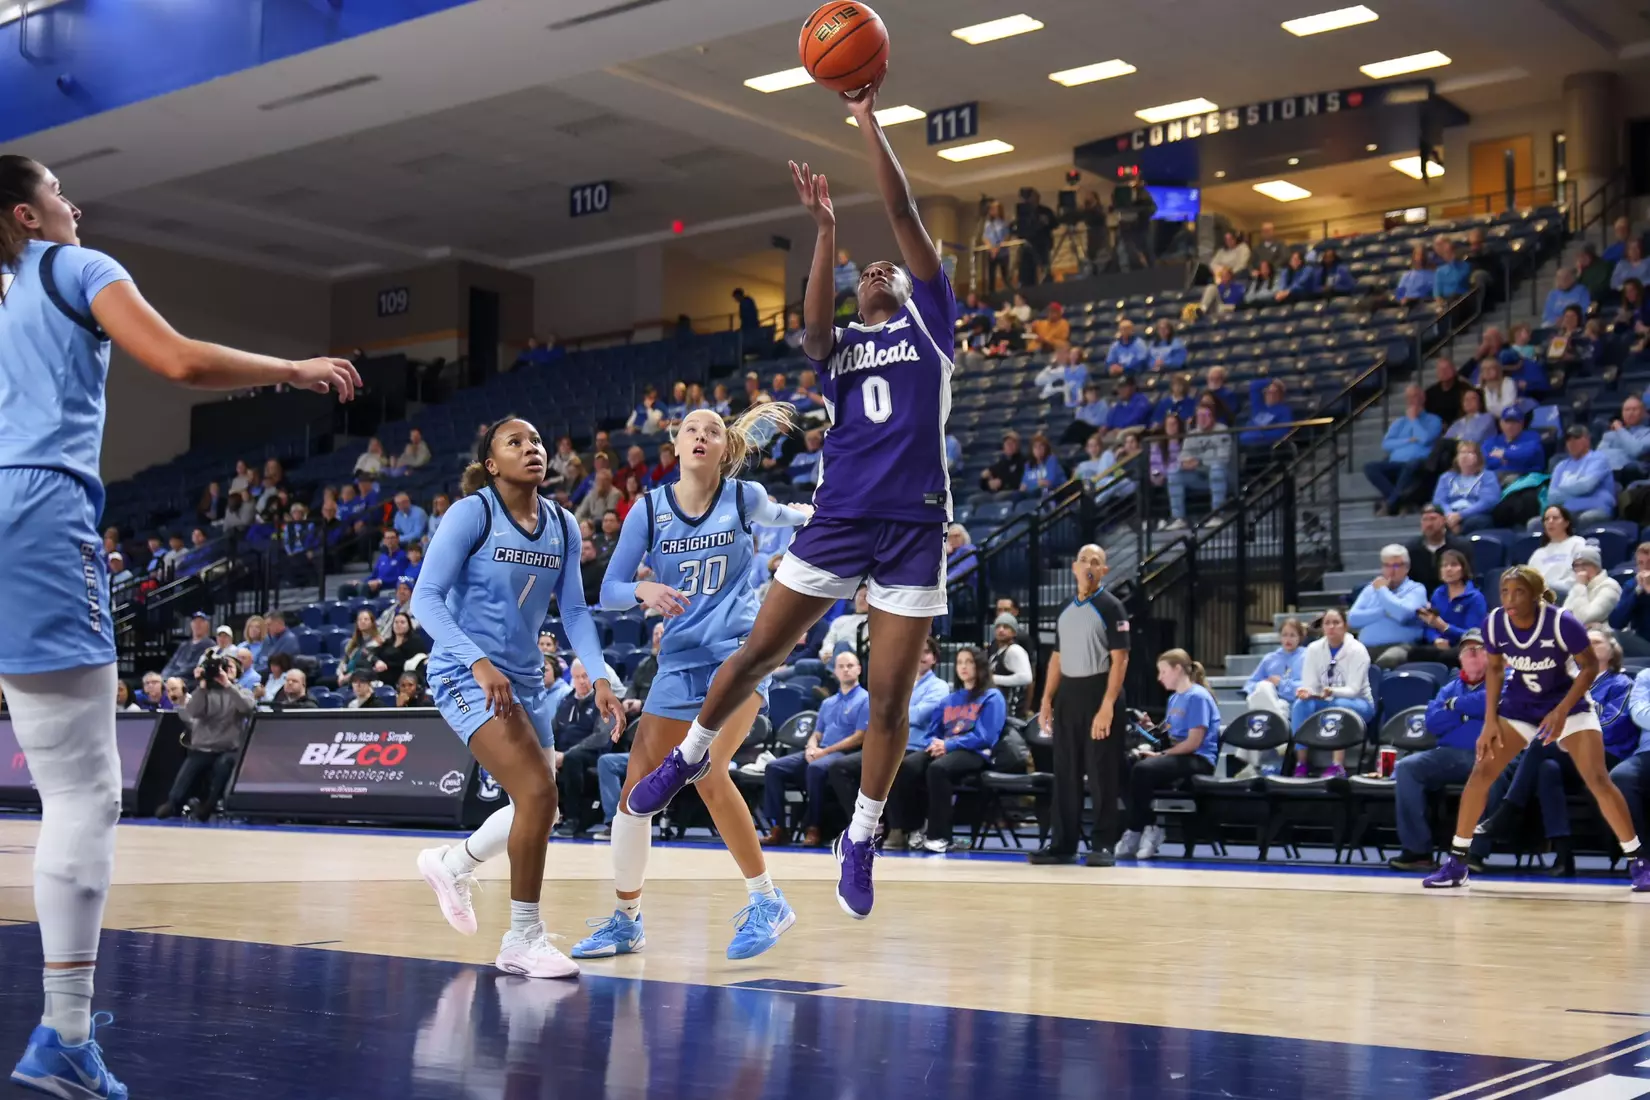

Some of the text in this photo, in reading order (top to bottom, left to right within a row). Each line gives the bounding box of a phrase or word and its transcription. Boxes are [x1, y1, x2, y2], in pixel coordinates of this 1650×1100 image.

[932, 106, 971, 140] 111
[1131, 92, 1341, 150] CONCESSIONS
[573, 184, 607, 214] 110
[380, 290, 407, 314] 109
[828, 339, 920, 381] Wildcats
[862, 375, 893, 424] 0
[661, 530, 735, 553] CREIGHTON
[493, 547, 561, 570] CREIGHTON
[678, 554, 728, 597] 30
[518, 573, 537, 609] 1
[1521, 673, 1543, 693] 5
[387, 730, 413, 744] Simple
[323, 768, 404, 783] technologies
